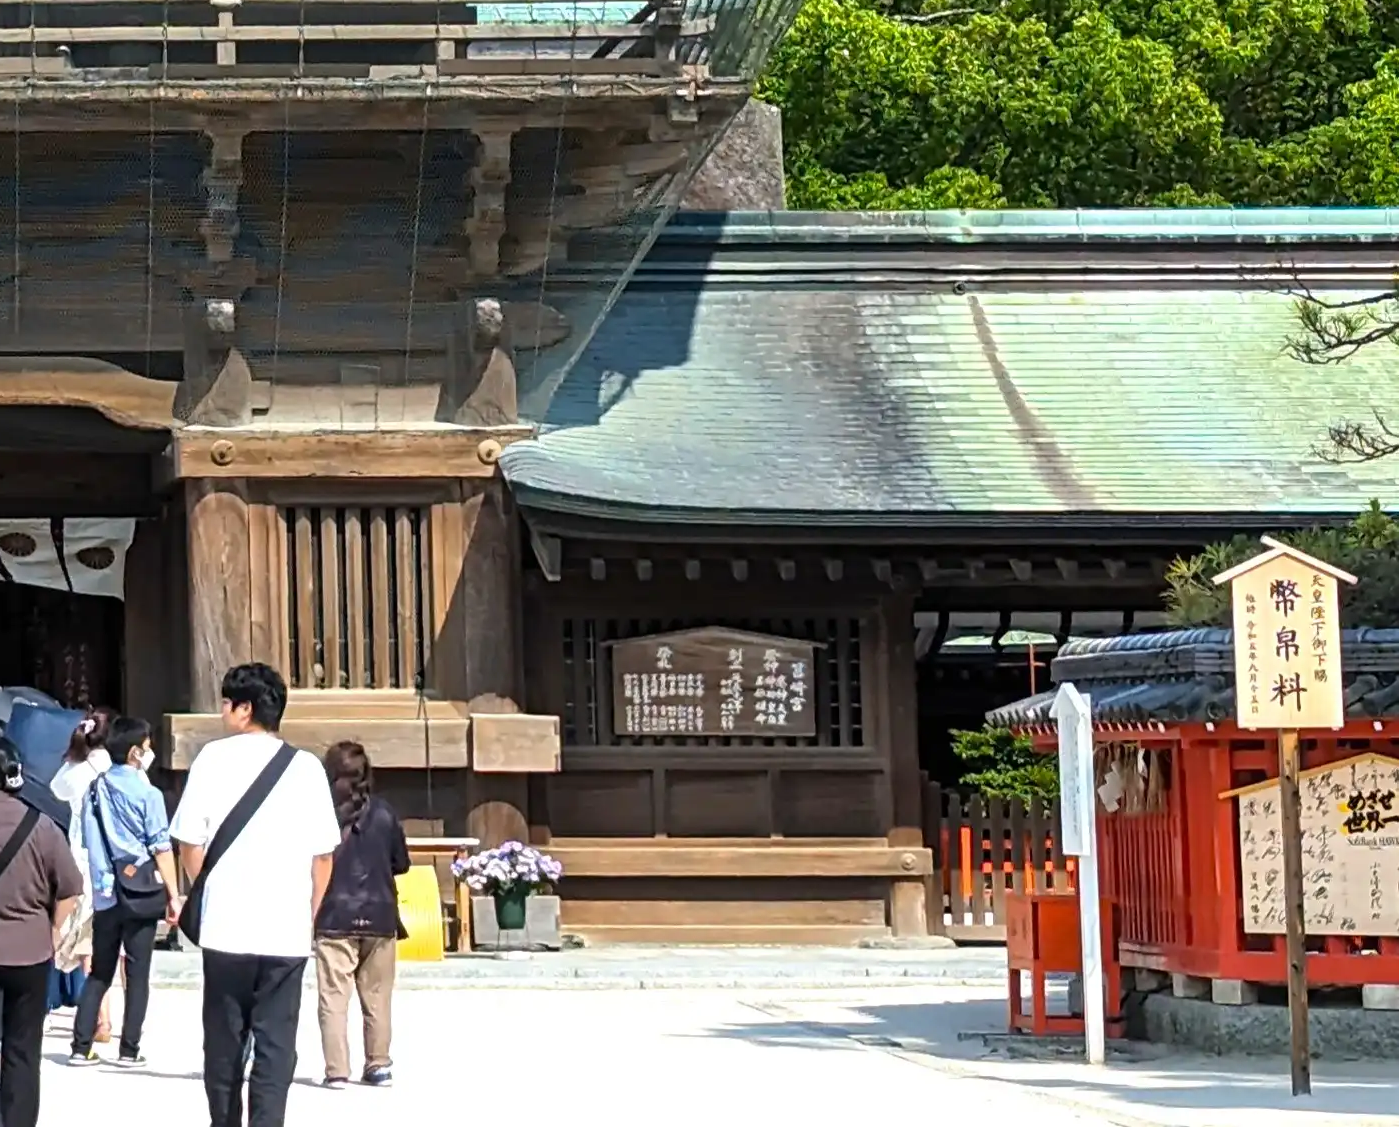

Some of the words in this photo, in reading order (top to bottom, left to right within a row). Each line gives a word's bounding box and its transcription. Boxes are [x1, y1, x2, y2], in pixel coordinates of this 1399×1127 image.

[1269, 579, 1308, 712] 幣帛料
[1346, 788, 1396, 811] めざせ
[1343, 811, 1399, 834] 世界一
